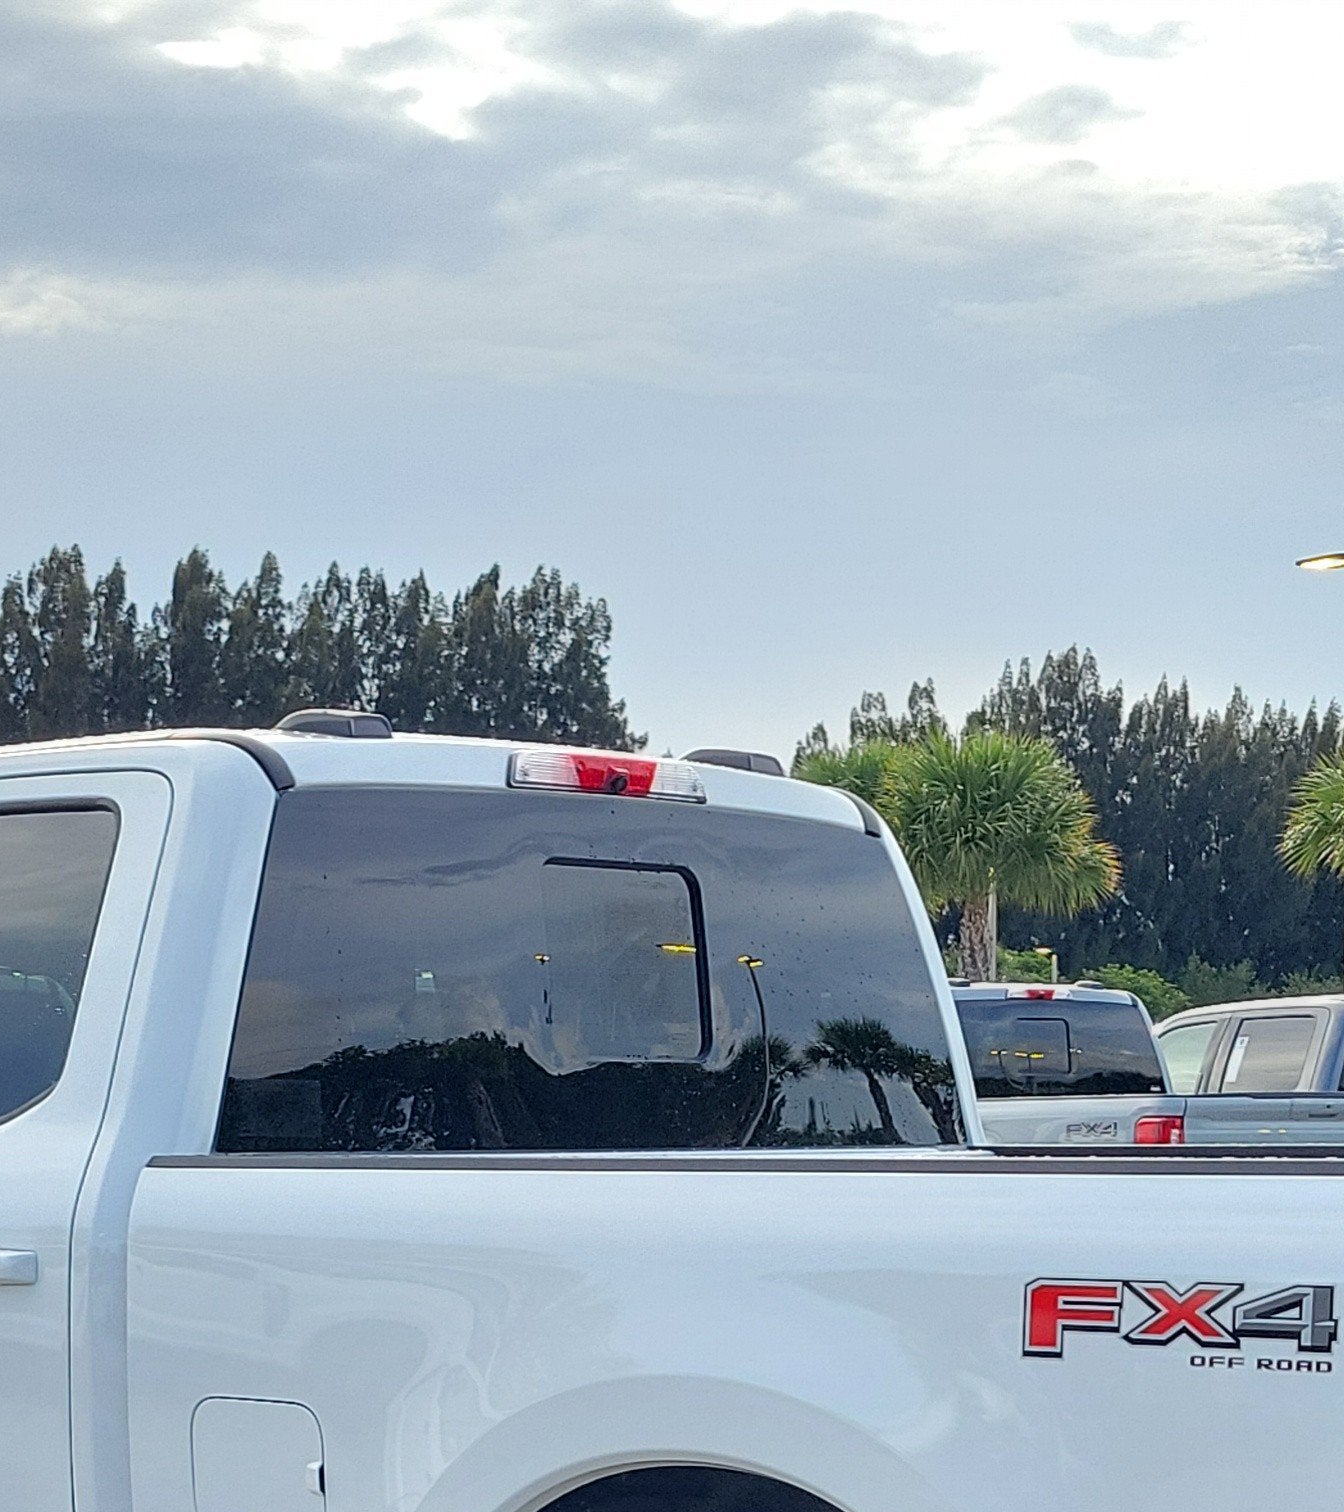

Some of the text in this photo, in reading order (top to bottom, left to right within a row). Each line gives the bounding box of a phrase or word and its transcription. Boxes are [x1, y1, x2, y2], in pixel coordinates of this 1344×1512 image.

[1065, 1121, 1118, 1138] FX4
[1022, 1277, 1338, 1358] FX4
[1189, 1355, 1333, 1373] OFF ROAD
